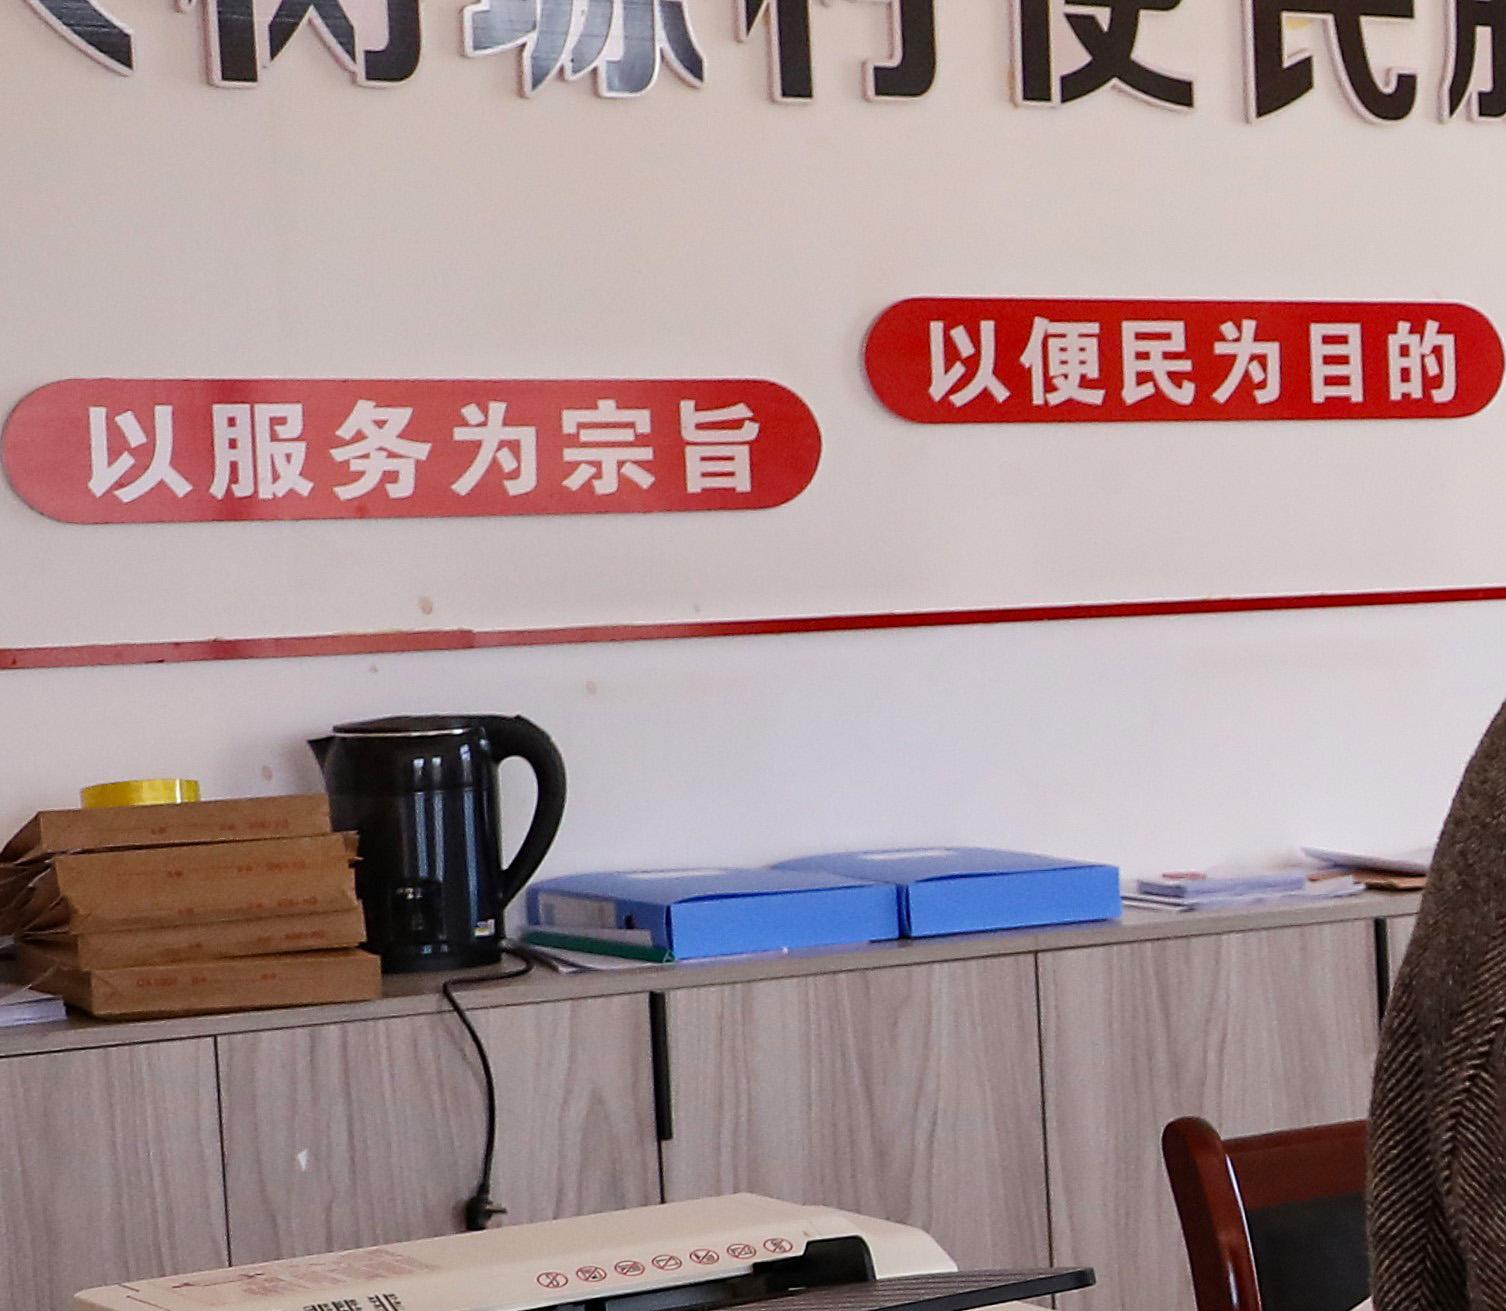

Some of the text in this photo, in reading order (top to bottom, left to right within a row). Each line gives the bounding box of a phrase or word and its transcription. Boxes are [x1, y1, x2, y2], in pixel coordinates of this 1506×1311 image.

[927, 317, 1458, 410] 以便民为目的
[86, 397, 762, 504] 以服务为宗旨
